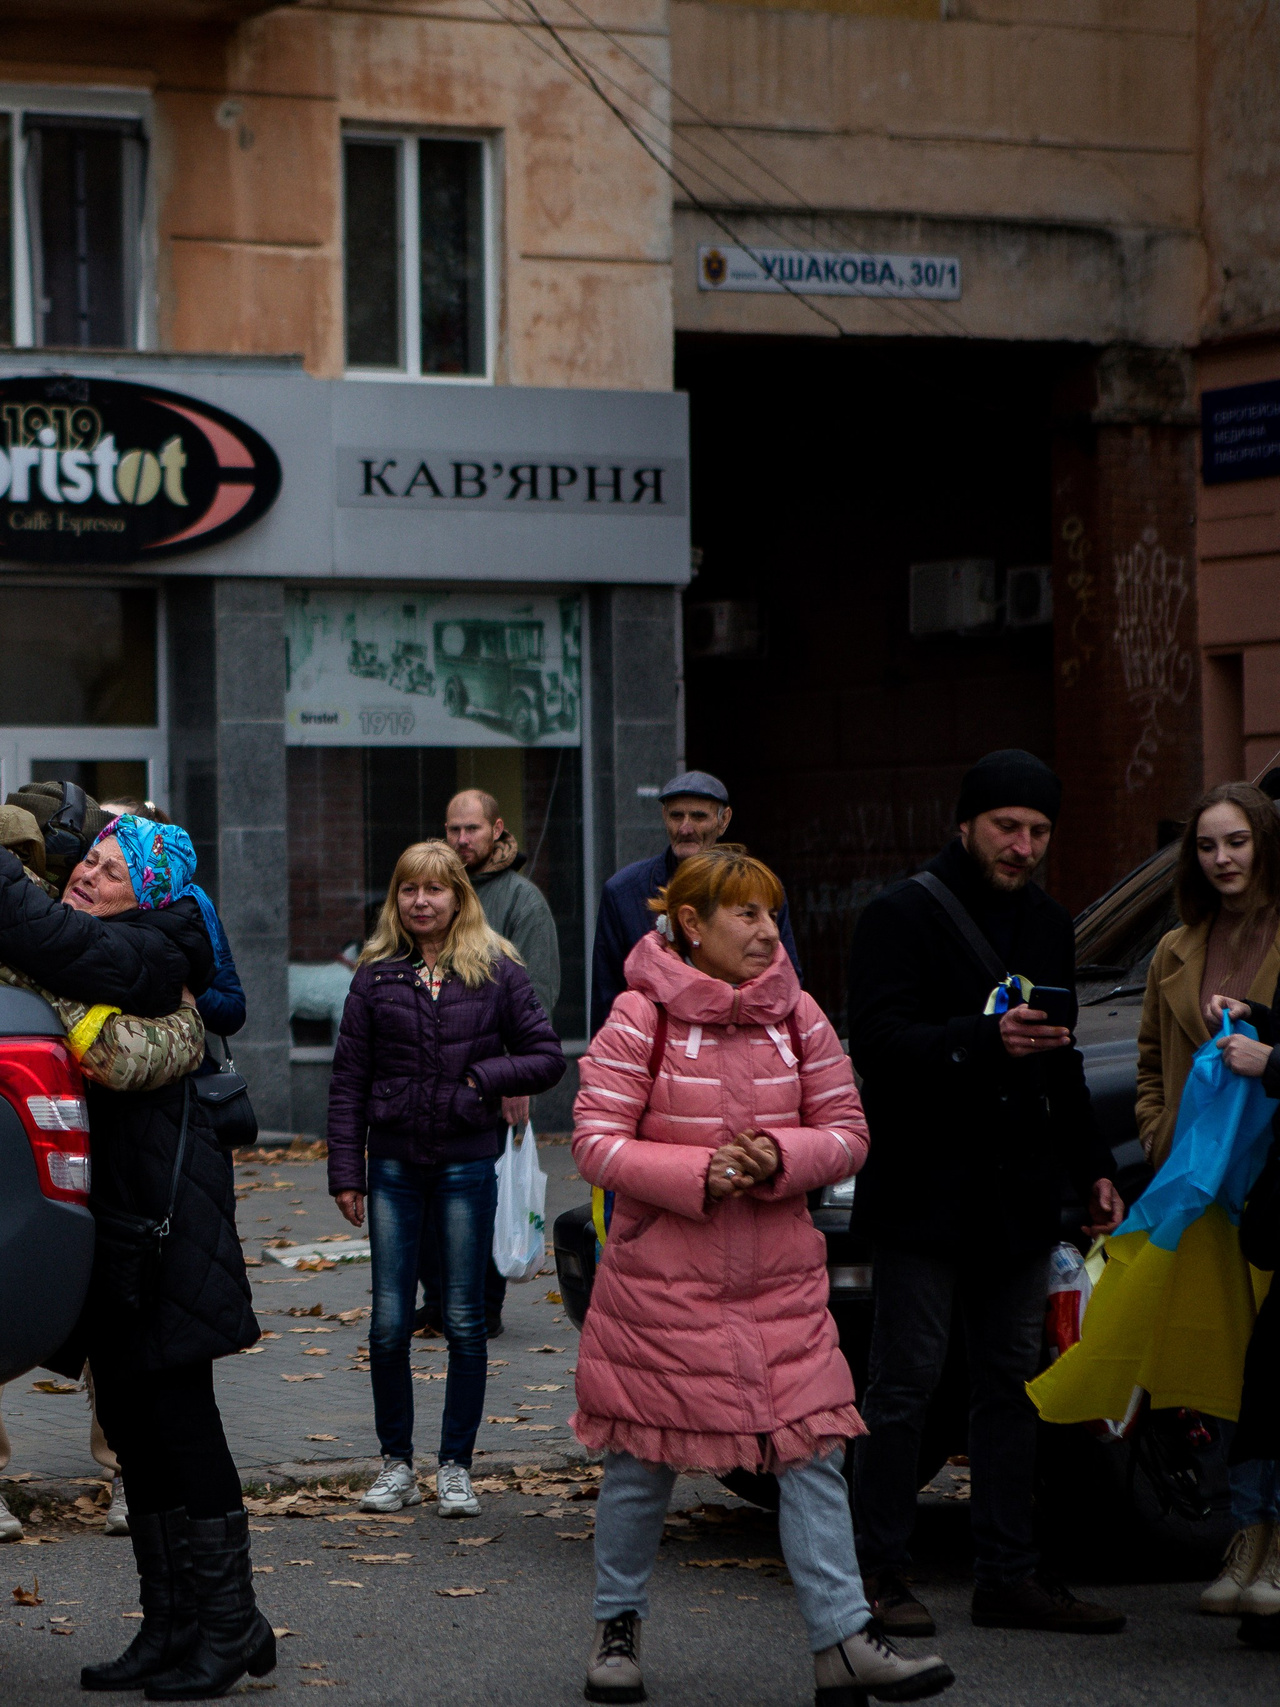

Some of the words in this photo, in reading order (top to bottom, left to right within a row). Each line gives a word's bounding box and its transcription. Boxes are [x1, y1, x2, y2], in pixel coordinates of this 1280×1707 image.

[761, 254, 904, 289] УШАКОВА,
[910, 261, 958, 288] 30/1
[2, 402, 102, 452] 1919
[358, 457, 668, 505] КАВ’ЯРНЯ
[57, 511, 126, 537] Espresso
[300, 710, 338, 725] bristot
[358, 711, 416, 735] 1919
